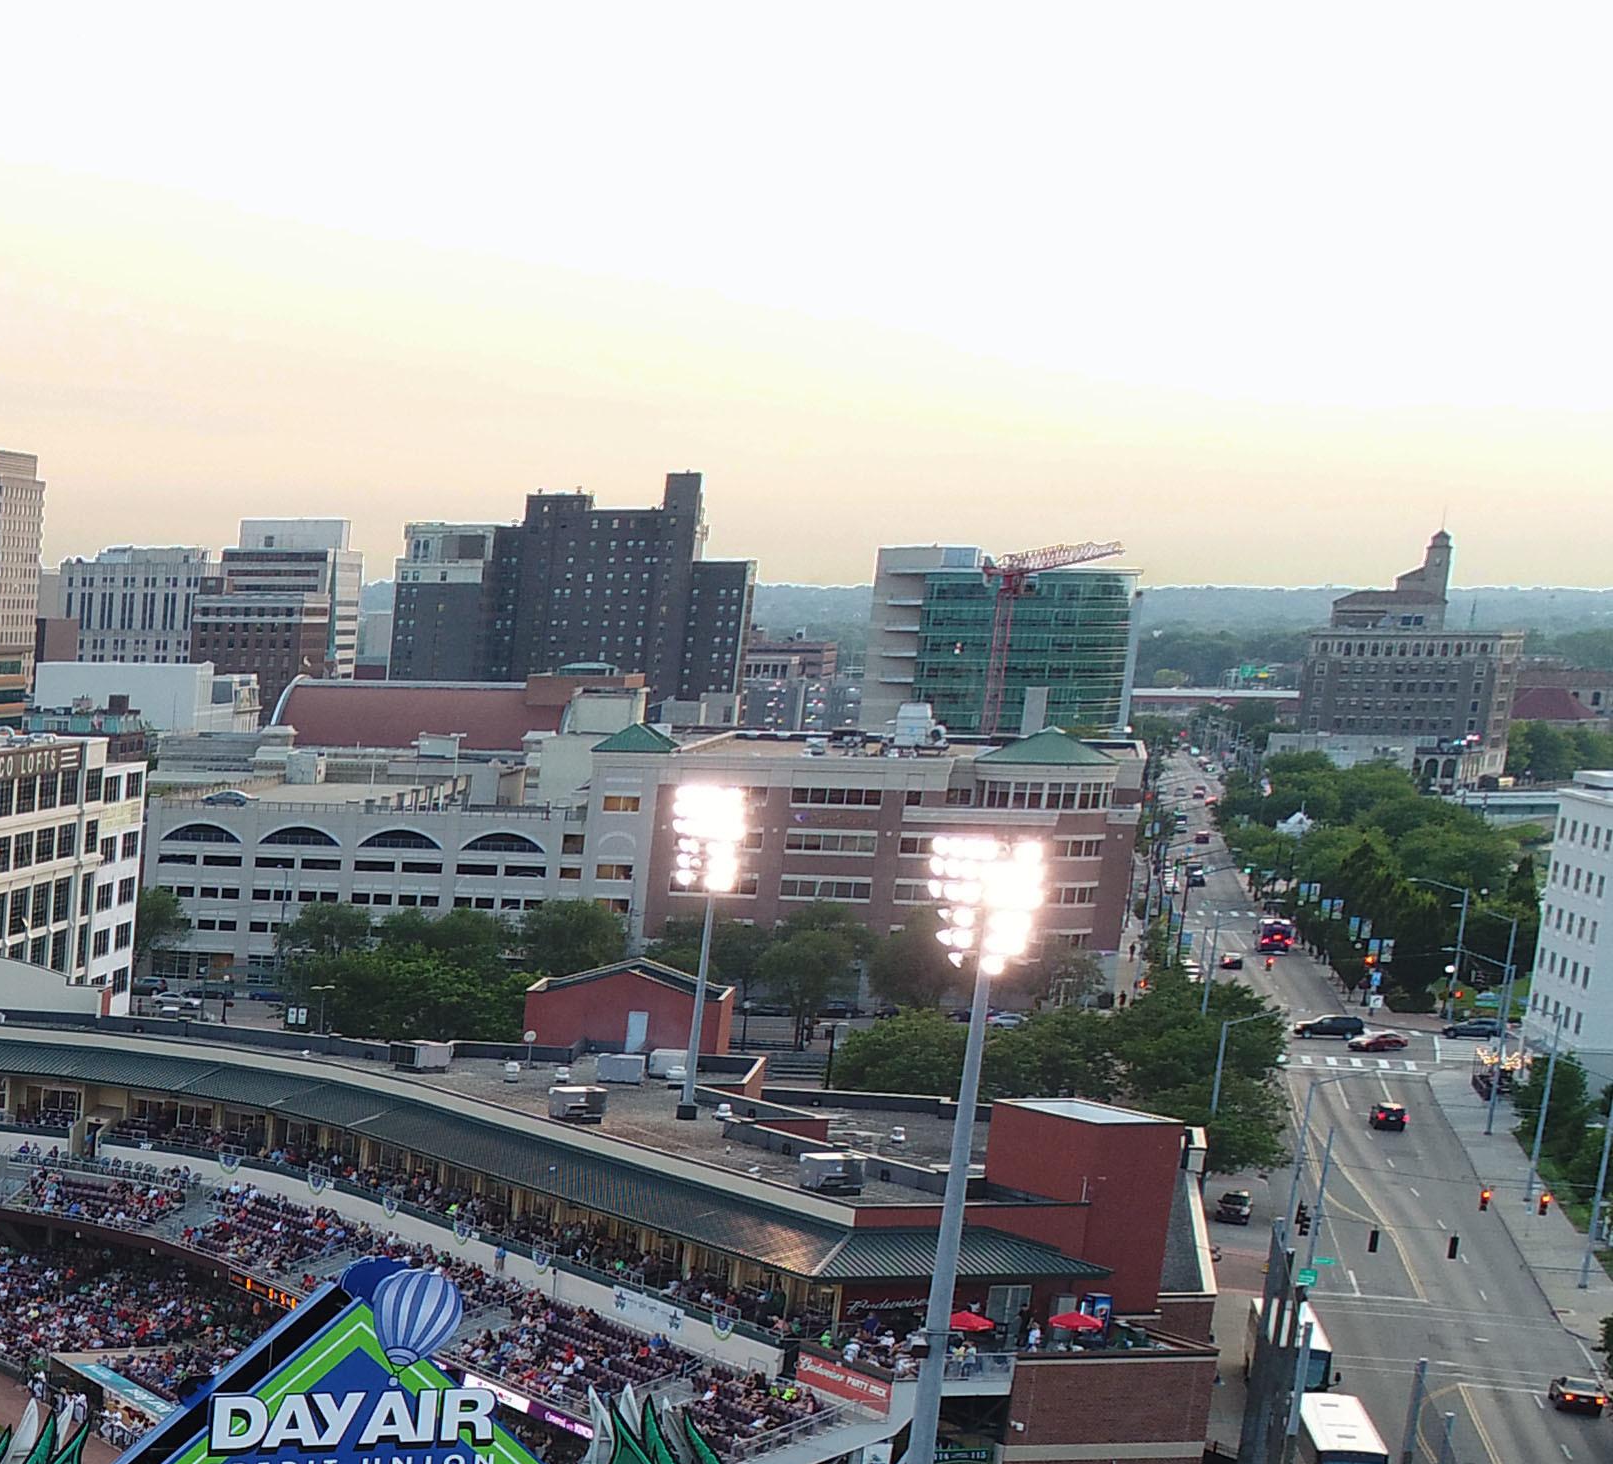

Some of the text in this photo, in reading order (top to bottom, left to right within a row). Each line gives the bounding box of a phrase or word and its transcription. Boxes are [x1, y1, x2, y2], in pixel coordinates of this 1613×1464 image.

[21, 749, 56, 774] LOFTS
[798, 1354, 846, 1382] Budweiser
[846, 1375, 869, 1391] PARTY
[210, 1391, 368, 1450] DAY
[358, 1388, 496, 1447] AIR
